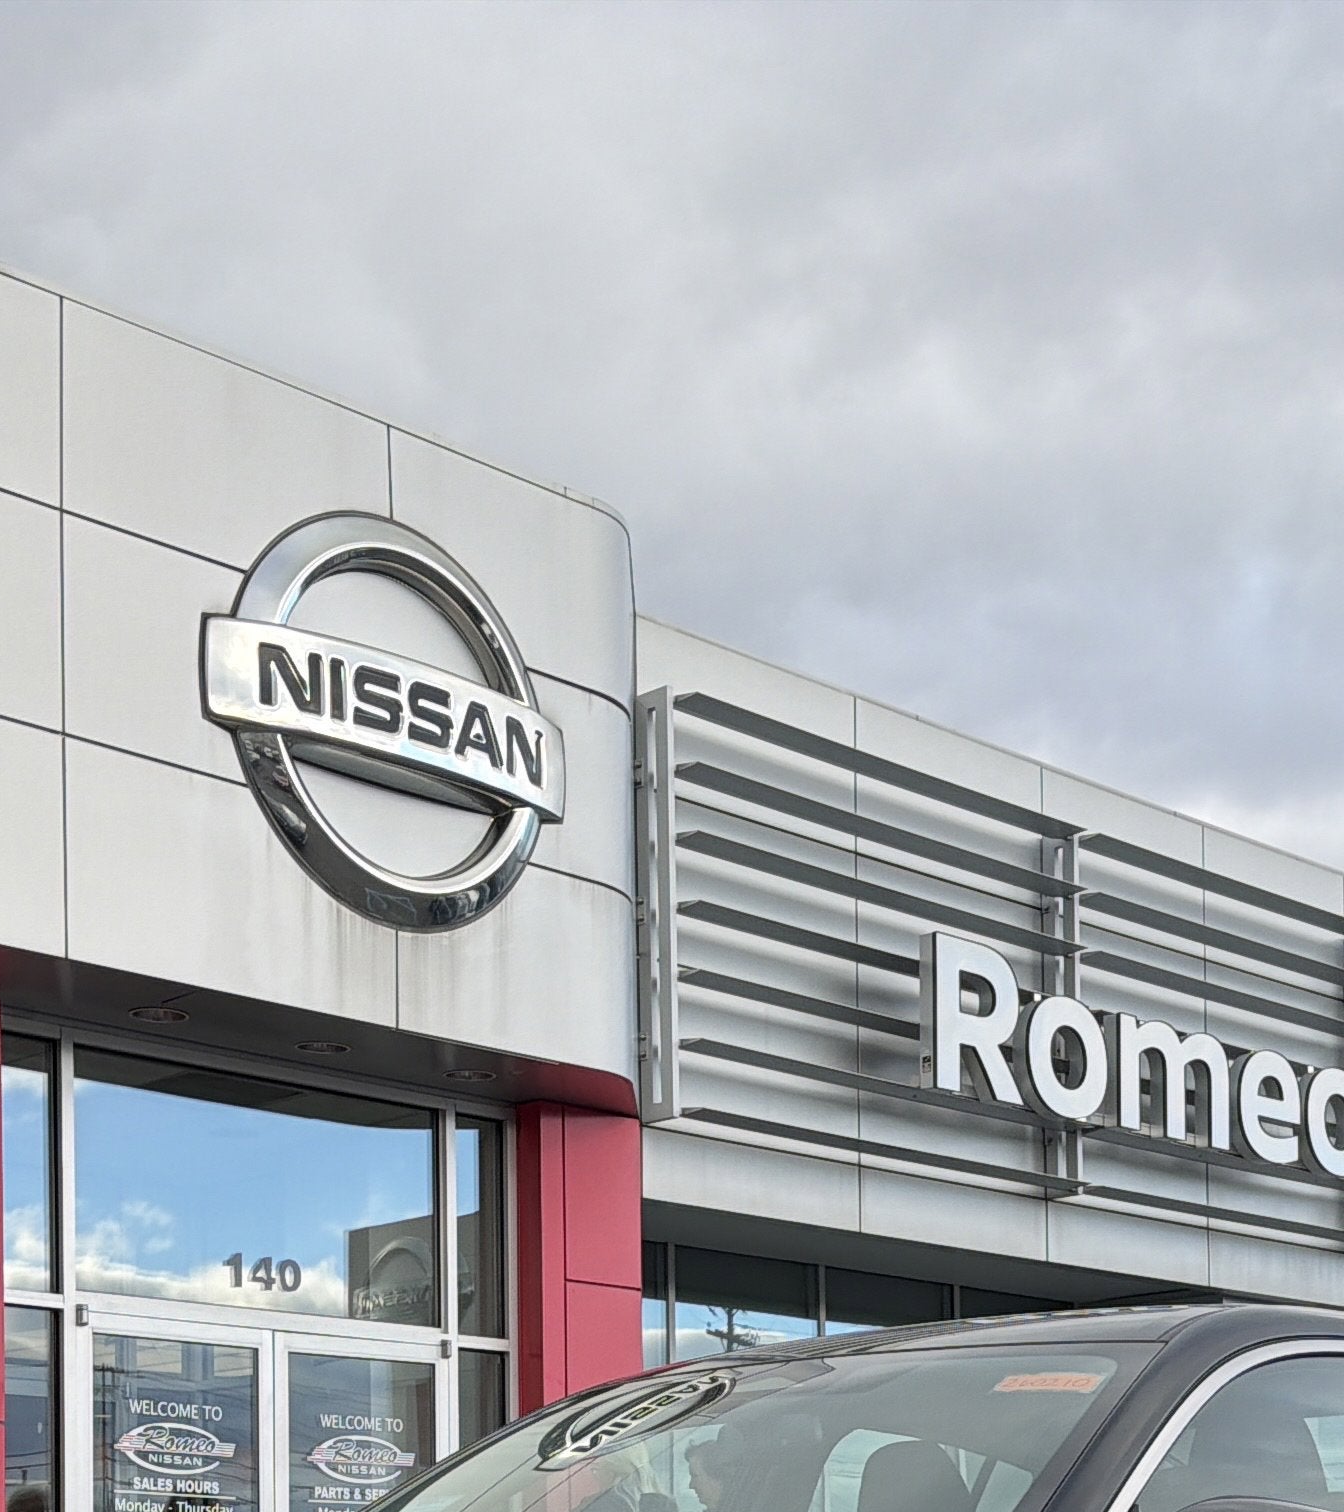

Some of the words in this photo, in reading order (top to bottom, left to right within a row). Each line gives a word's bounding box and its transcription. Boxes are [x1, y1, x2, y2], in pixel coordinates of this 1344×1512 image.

[258, 642, 544, 790] NISSAN
[223, 1252, 302, 1292] 140
[129, 1399, 200, 1419] WELCOME
[202, 1405, 223, 1421] TO
[320, 1414, 382, 1432] WELCOME
[385, 1418, 404, 1432] TO
[137, 1425, 216, 1453] Romeo
[148, 1453, 203, 1467] NISSAN
[331, 1438, 398, 1464] Romeo
[337, 1464, 386, 1476] NISSAN
[133, 1477, 173, 1492] SALES
[176, 1479, 220, 1494] HOURS
[314, 1486, 351, 1500] PARTS
[353, 1488, 362, 1500] &
[364, 1488, 389, 1502] SER
